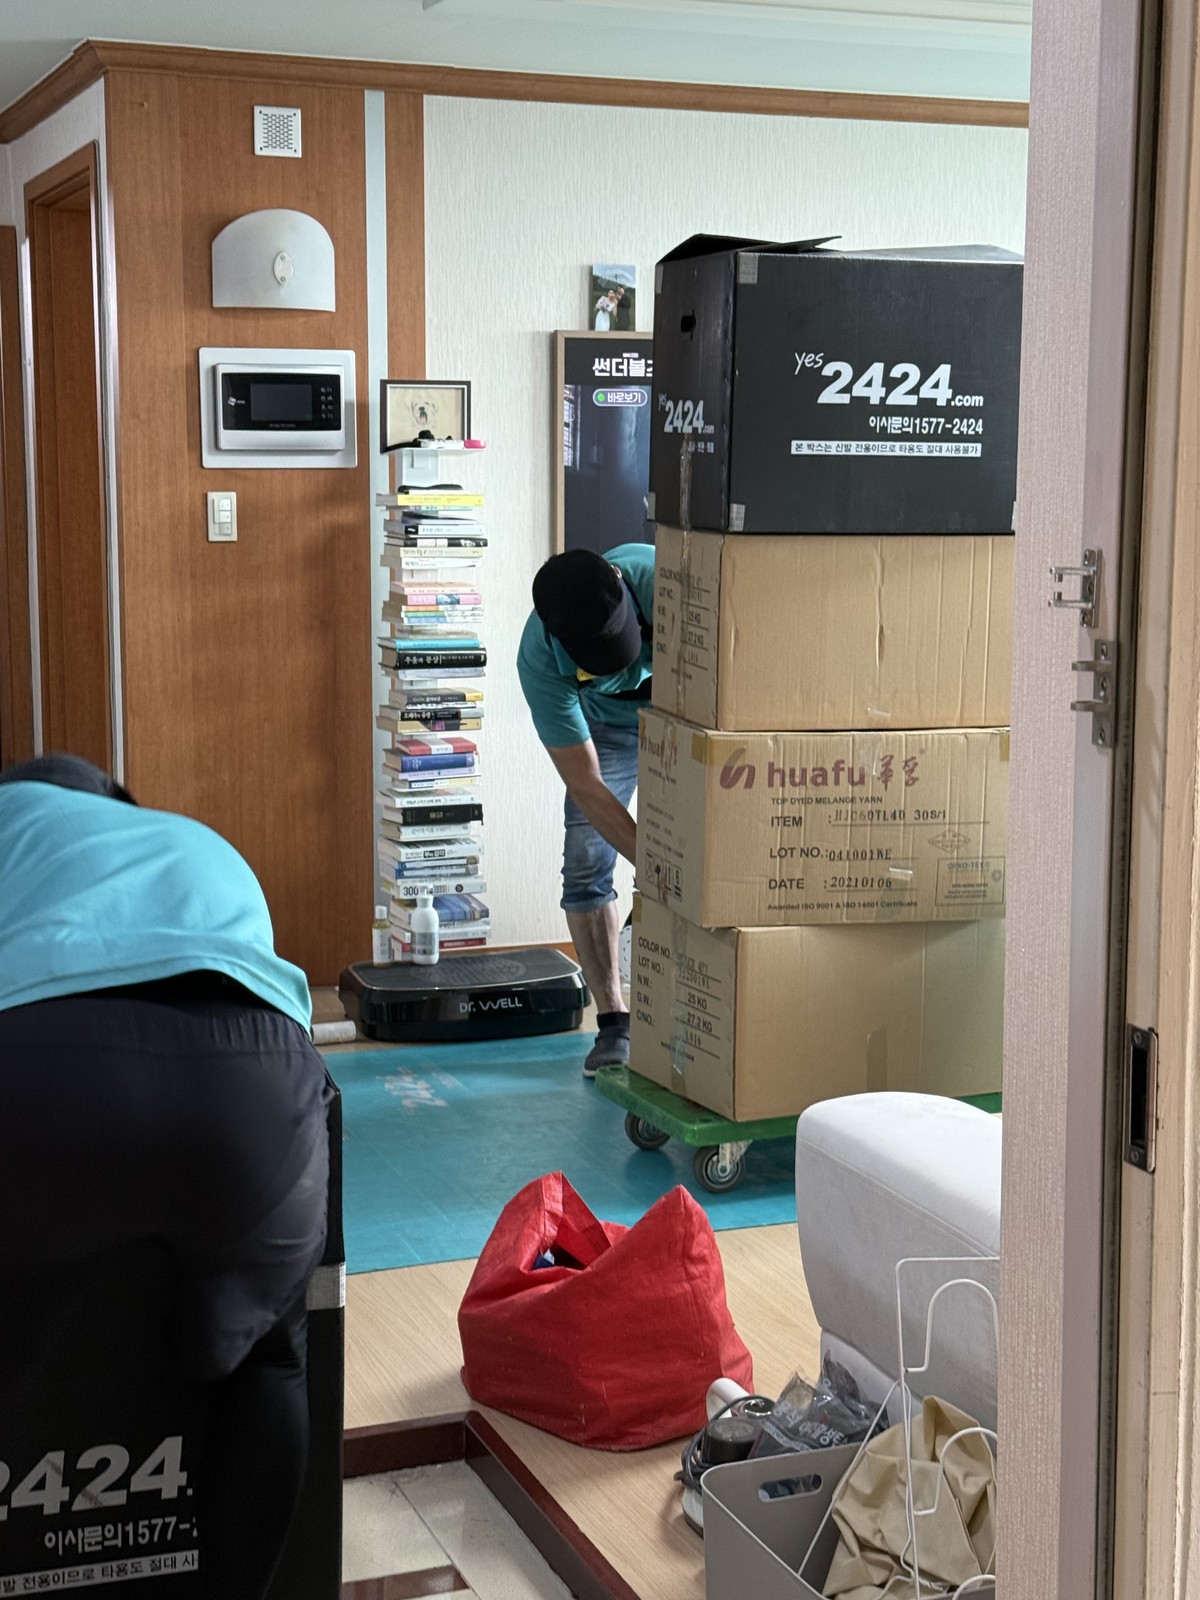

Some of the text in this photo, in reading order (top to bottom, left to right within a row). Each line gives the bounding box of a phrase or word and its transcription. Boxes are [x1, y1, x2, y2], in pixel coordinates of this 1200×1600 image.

[607, 392, 641, 404] 바로보기
[806, 443, 832, 453] 박스는
[835, 443, 852, 454] 신발
[855, 443, 896, 454] 전용이므로
[899, 444, 924, 454] 타용도
[926, 444, 943, 455] 절대
[945, 445, 978, 455] 사용불가
[767, 760, 865, 788] huafu
[790, 797, 814, 805] DYED
[815, 797, 857, 805] MELANGE
[860, 796, 883, 804] YARN
[770, 816, 802, 828] ITEM
[769, 847, 796, 859] LOT
[768, 878, 805, 890] DATE
[403, 886, 419, 896] 300
[767, 903, 800, 911] Awarded
[801, 902, 815, 910] ISO
[816, 902, 833, 910] 9001
[638, 935, 660, 955] COLOR
[638, 955, 651, 968] LOT
[459, 996, 523, 1014] Dr. WELL
[687, 992, 708, 1010] 25 KG
[686, 1012, 713, 1033] 27.2 KG
[0, 1436, 193, 1521] 424.
[44, 1516, 198, 1556] 이사문의1577-
[22, 1567, 95, 1592] 전용이므로
[101, 1560, 144, 1579] 타용도
[150, 1556, 178, 1573] 절대
